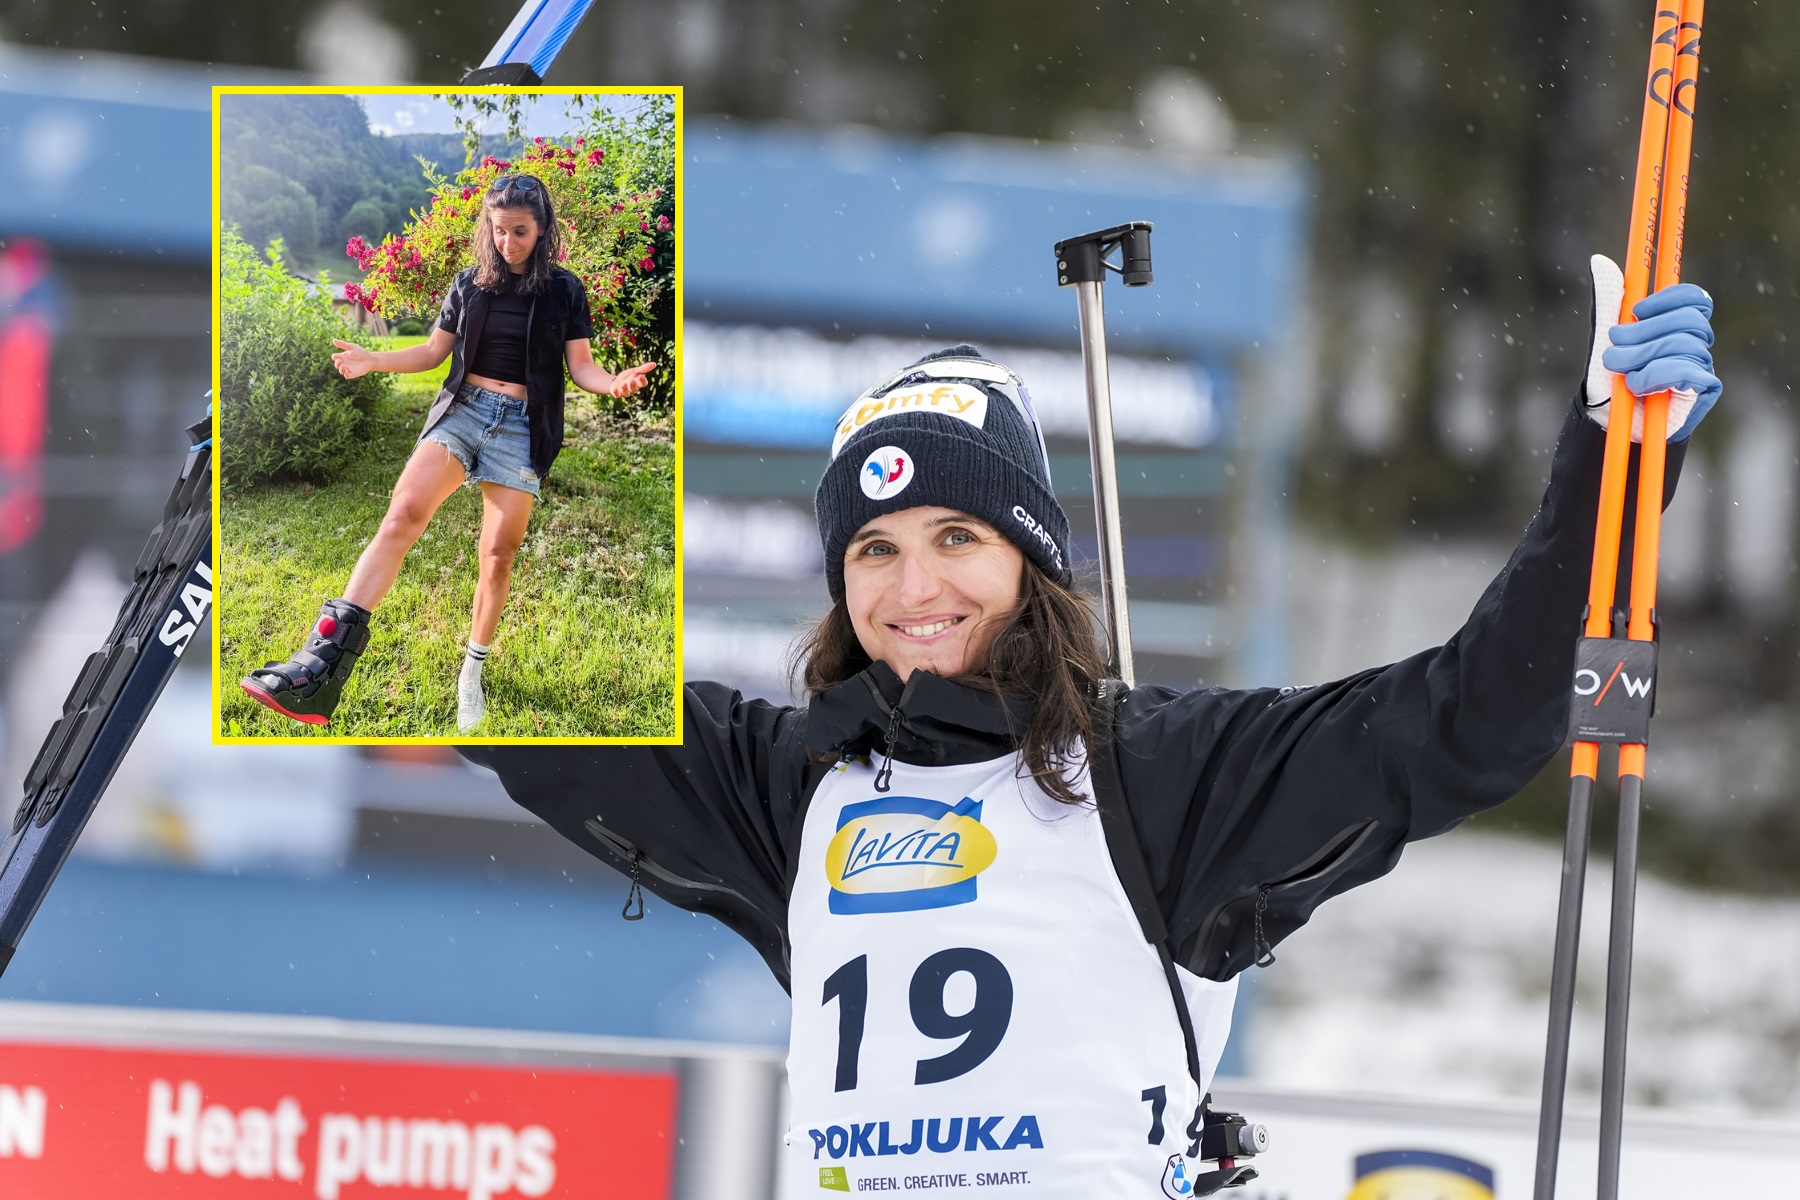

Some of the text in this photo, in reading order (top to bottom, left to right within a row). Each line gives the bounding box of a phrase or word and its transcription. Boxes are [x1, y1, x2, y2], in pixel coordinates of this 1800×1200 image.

[839, 387, 975, 443] somfy
[1012, 505, 1058, 556] CRAFT
[821, 947, 1014, 1093] 19
[145, 1078, 308, 1182] Heat
[315, 1112, 558, 1200] pumps
[808, 1115, 1045, 1160] POKLJUKA
[857, 1171, 1031, 1192] GREEN. CREATIVE. SMART.
